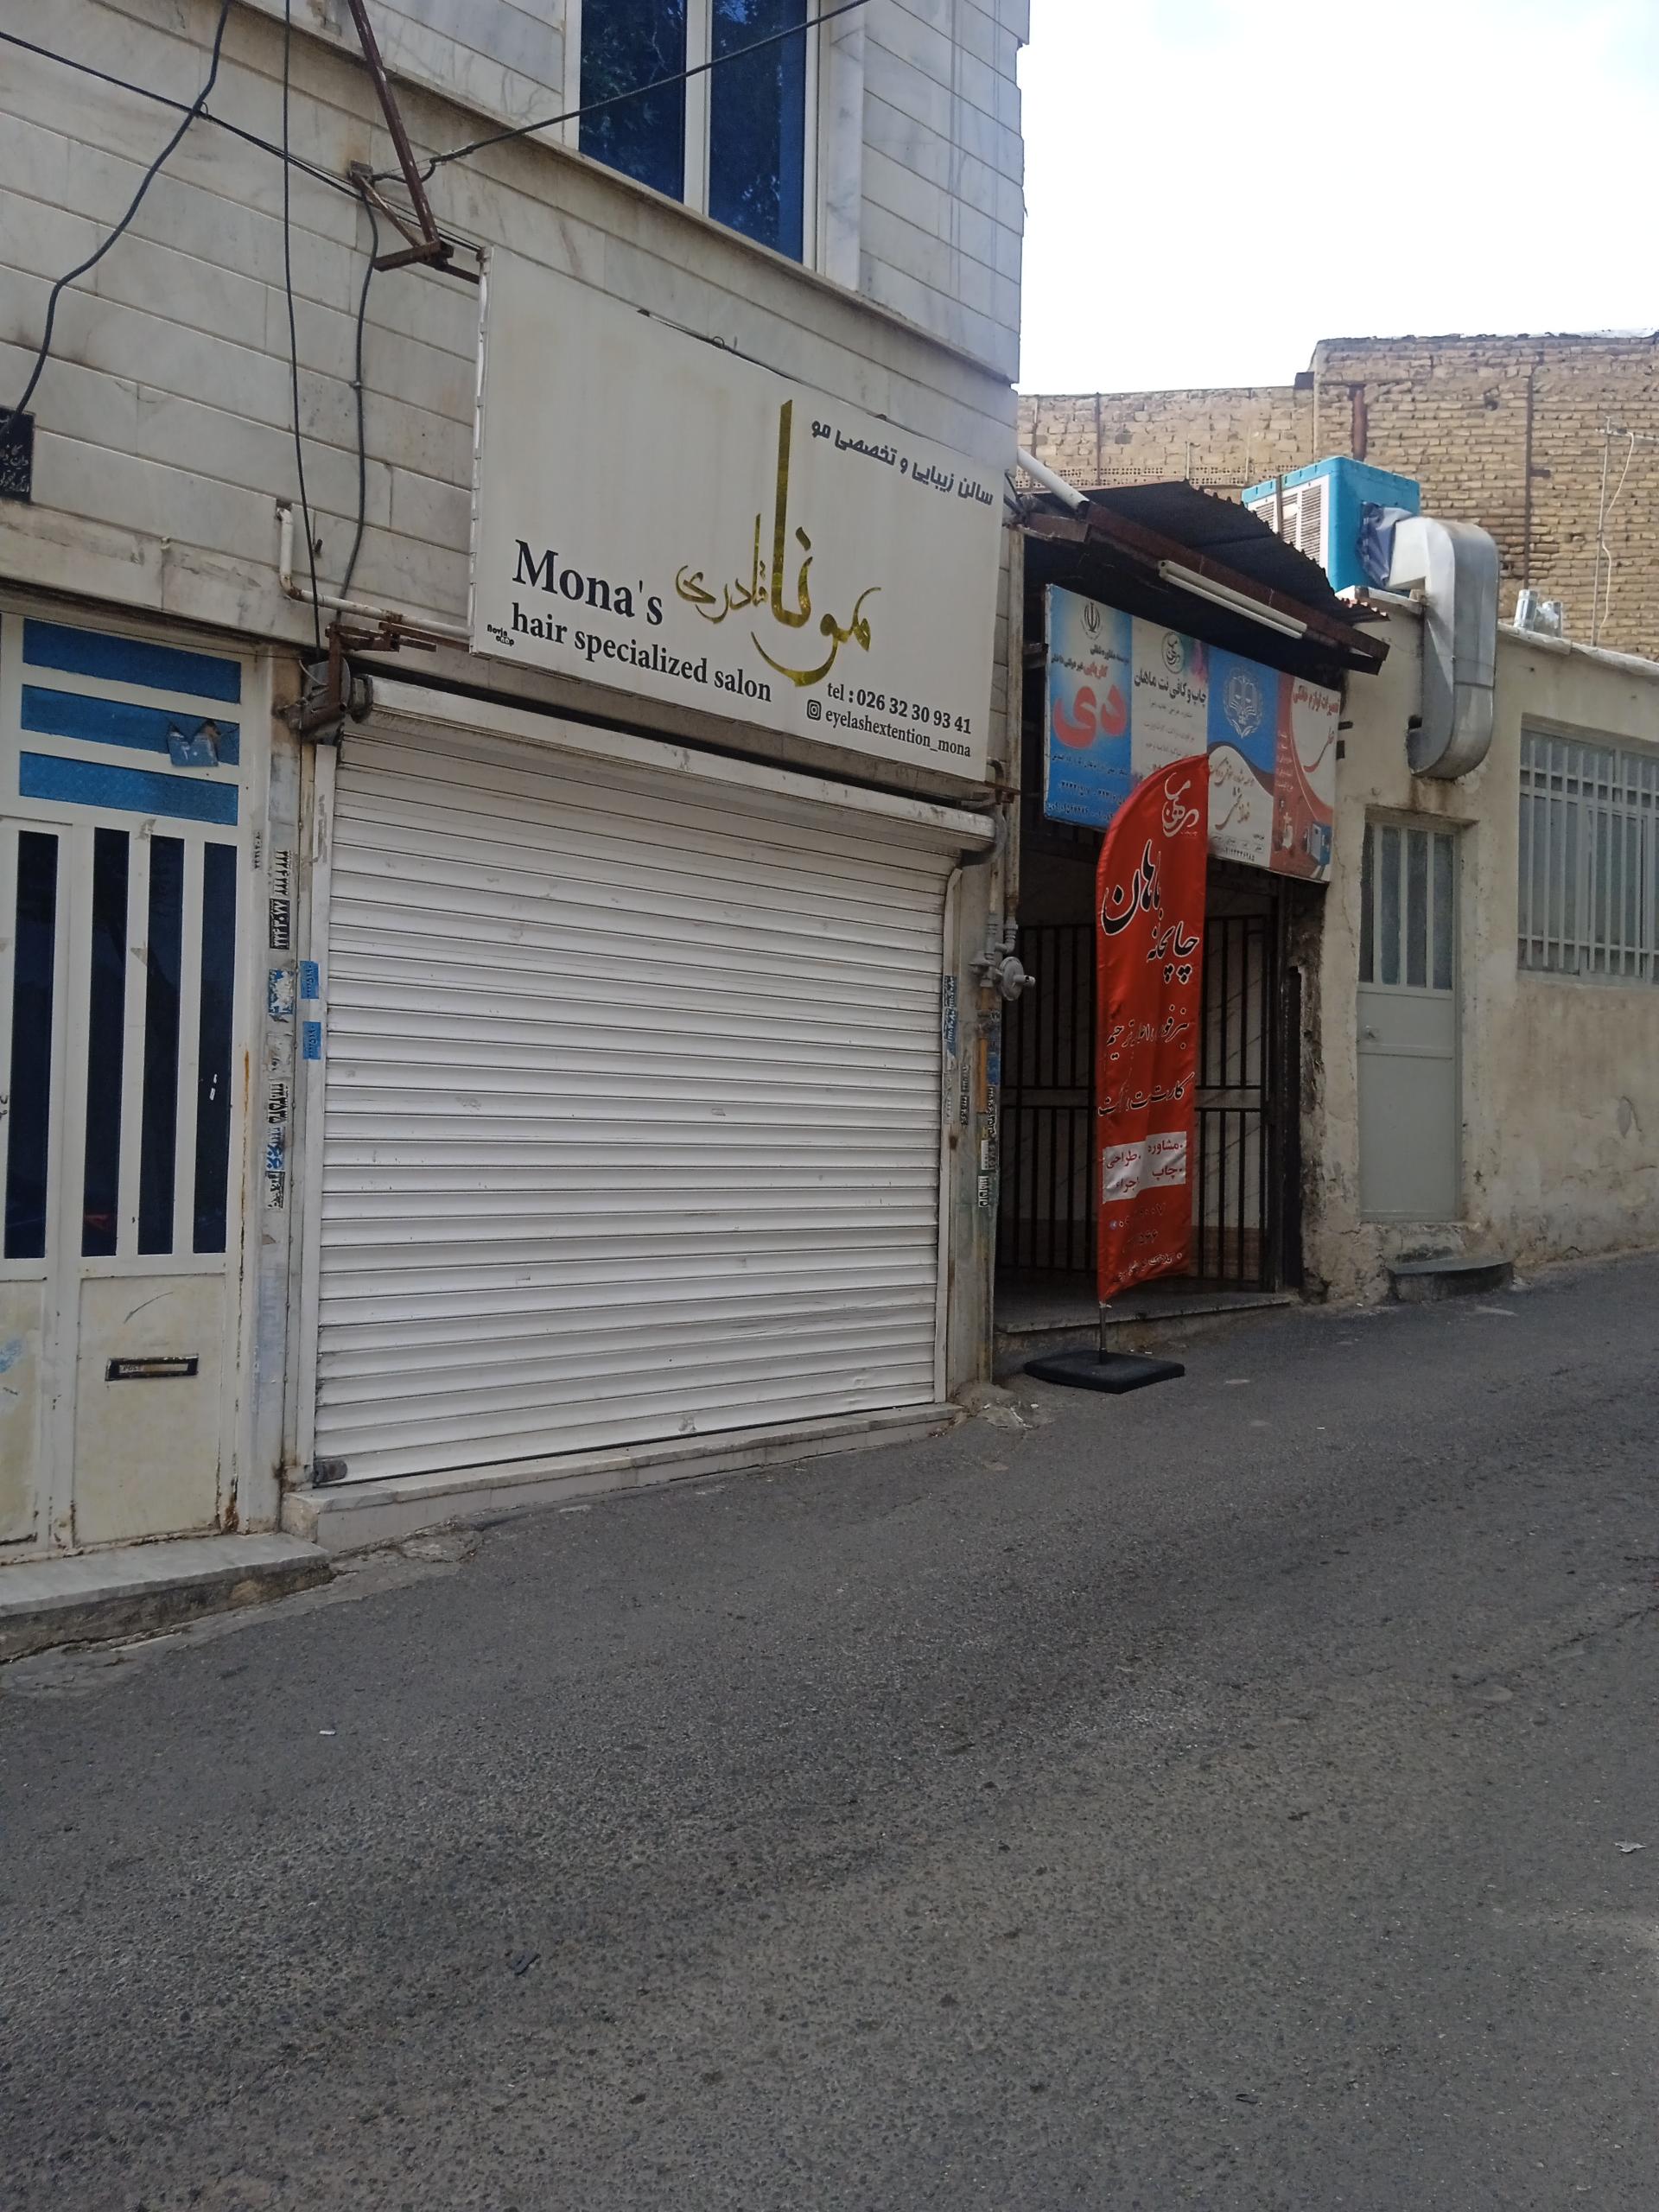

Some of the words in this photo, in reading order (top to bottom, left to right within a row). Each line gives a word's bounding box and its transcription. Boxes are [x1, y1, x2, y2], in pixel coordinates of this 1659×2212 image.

[810, 420, 831, 439] مو
[834, 429, 898, 466] تخصصی
[899, 457, 908, 474] و
[912, 461, 955, 493] زیبایی
[957, 477, 994, 506] سالن
[512, 538, 664, 626] Mona's
[511, 601, 569, 645] hair
[573, 629, 709, 684] specialized
[713, 667, 772, 703] salon
[1134, 667, 1157, 688] ماهان
[827, 682, 844, 702] tel
[856, 689, 886, 711] 026
[889, 697, 908, 718] 32
[912, 703, 930, 723] 30
[933, 709, 951, 729] 93
[954, 715, 972, 734] 41
[1192, 689, 1207, 709] چاپ
[1052, 683, 1128, 750] دی
[825, 709, 971, 758] eyelashextention_mona
[1106, 1150, 1138, 1170] طراحی
[1147, 1139, 1179, 1155] مشاوره
[1152, 1165, 1179, 1181] چاپ
